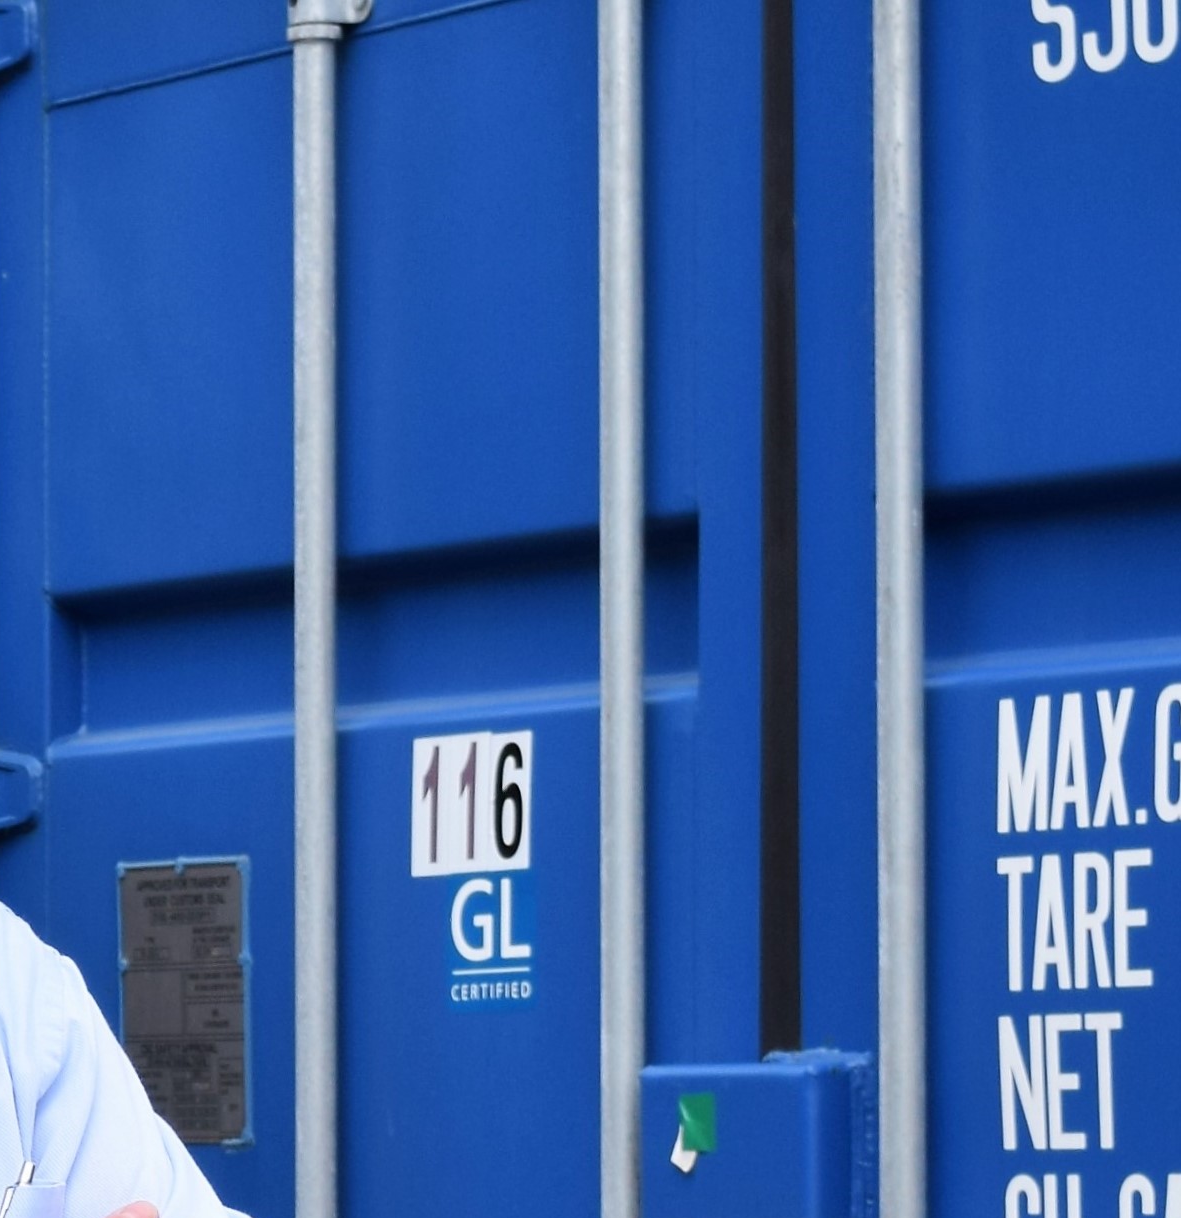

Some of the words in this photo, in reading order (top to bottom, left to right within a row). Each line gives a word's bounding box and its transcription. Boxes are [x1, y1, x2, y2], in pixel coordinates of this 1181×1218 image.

[422, 741, 524, 864] 116
[451, 878, 532, 962] GL
[997, 848, 1153, 991] TARE
[450, 981, 531, 1002] CERTIFIED
[998, 1012, 1123, 1151] NET
